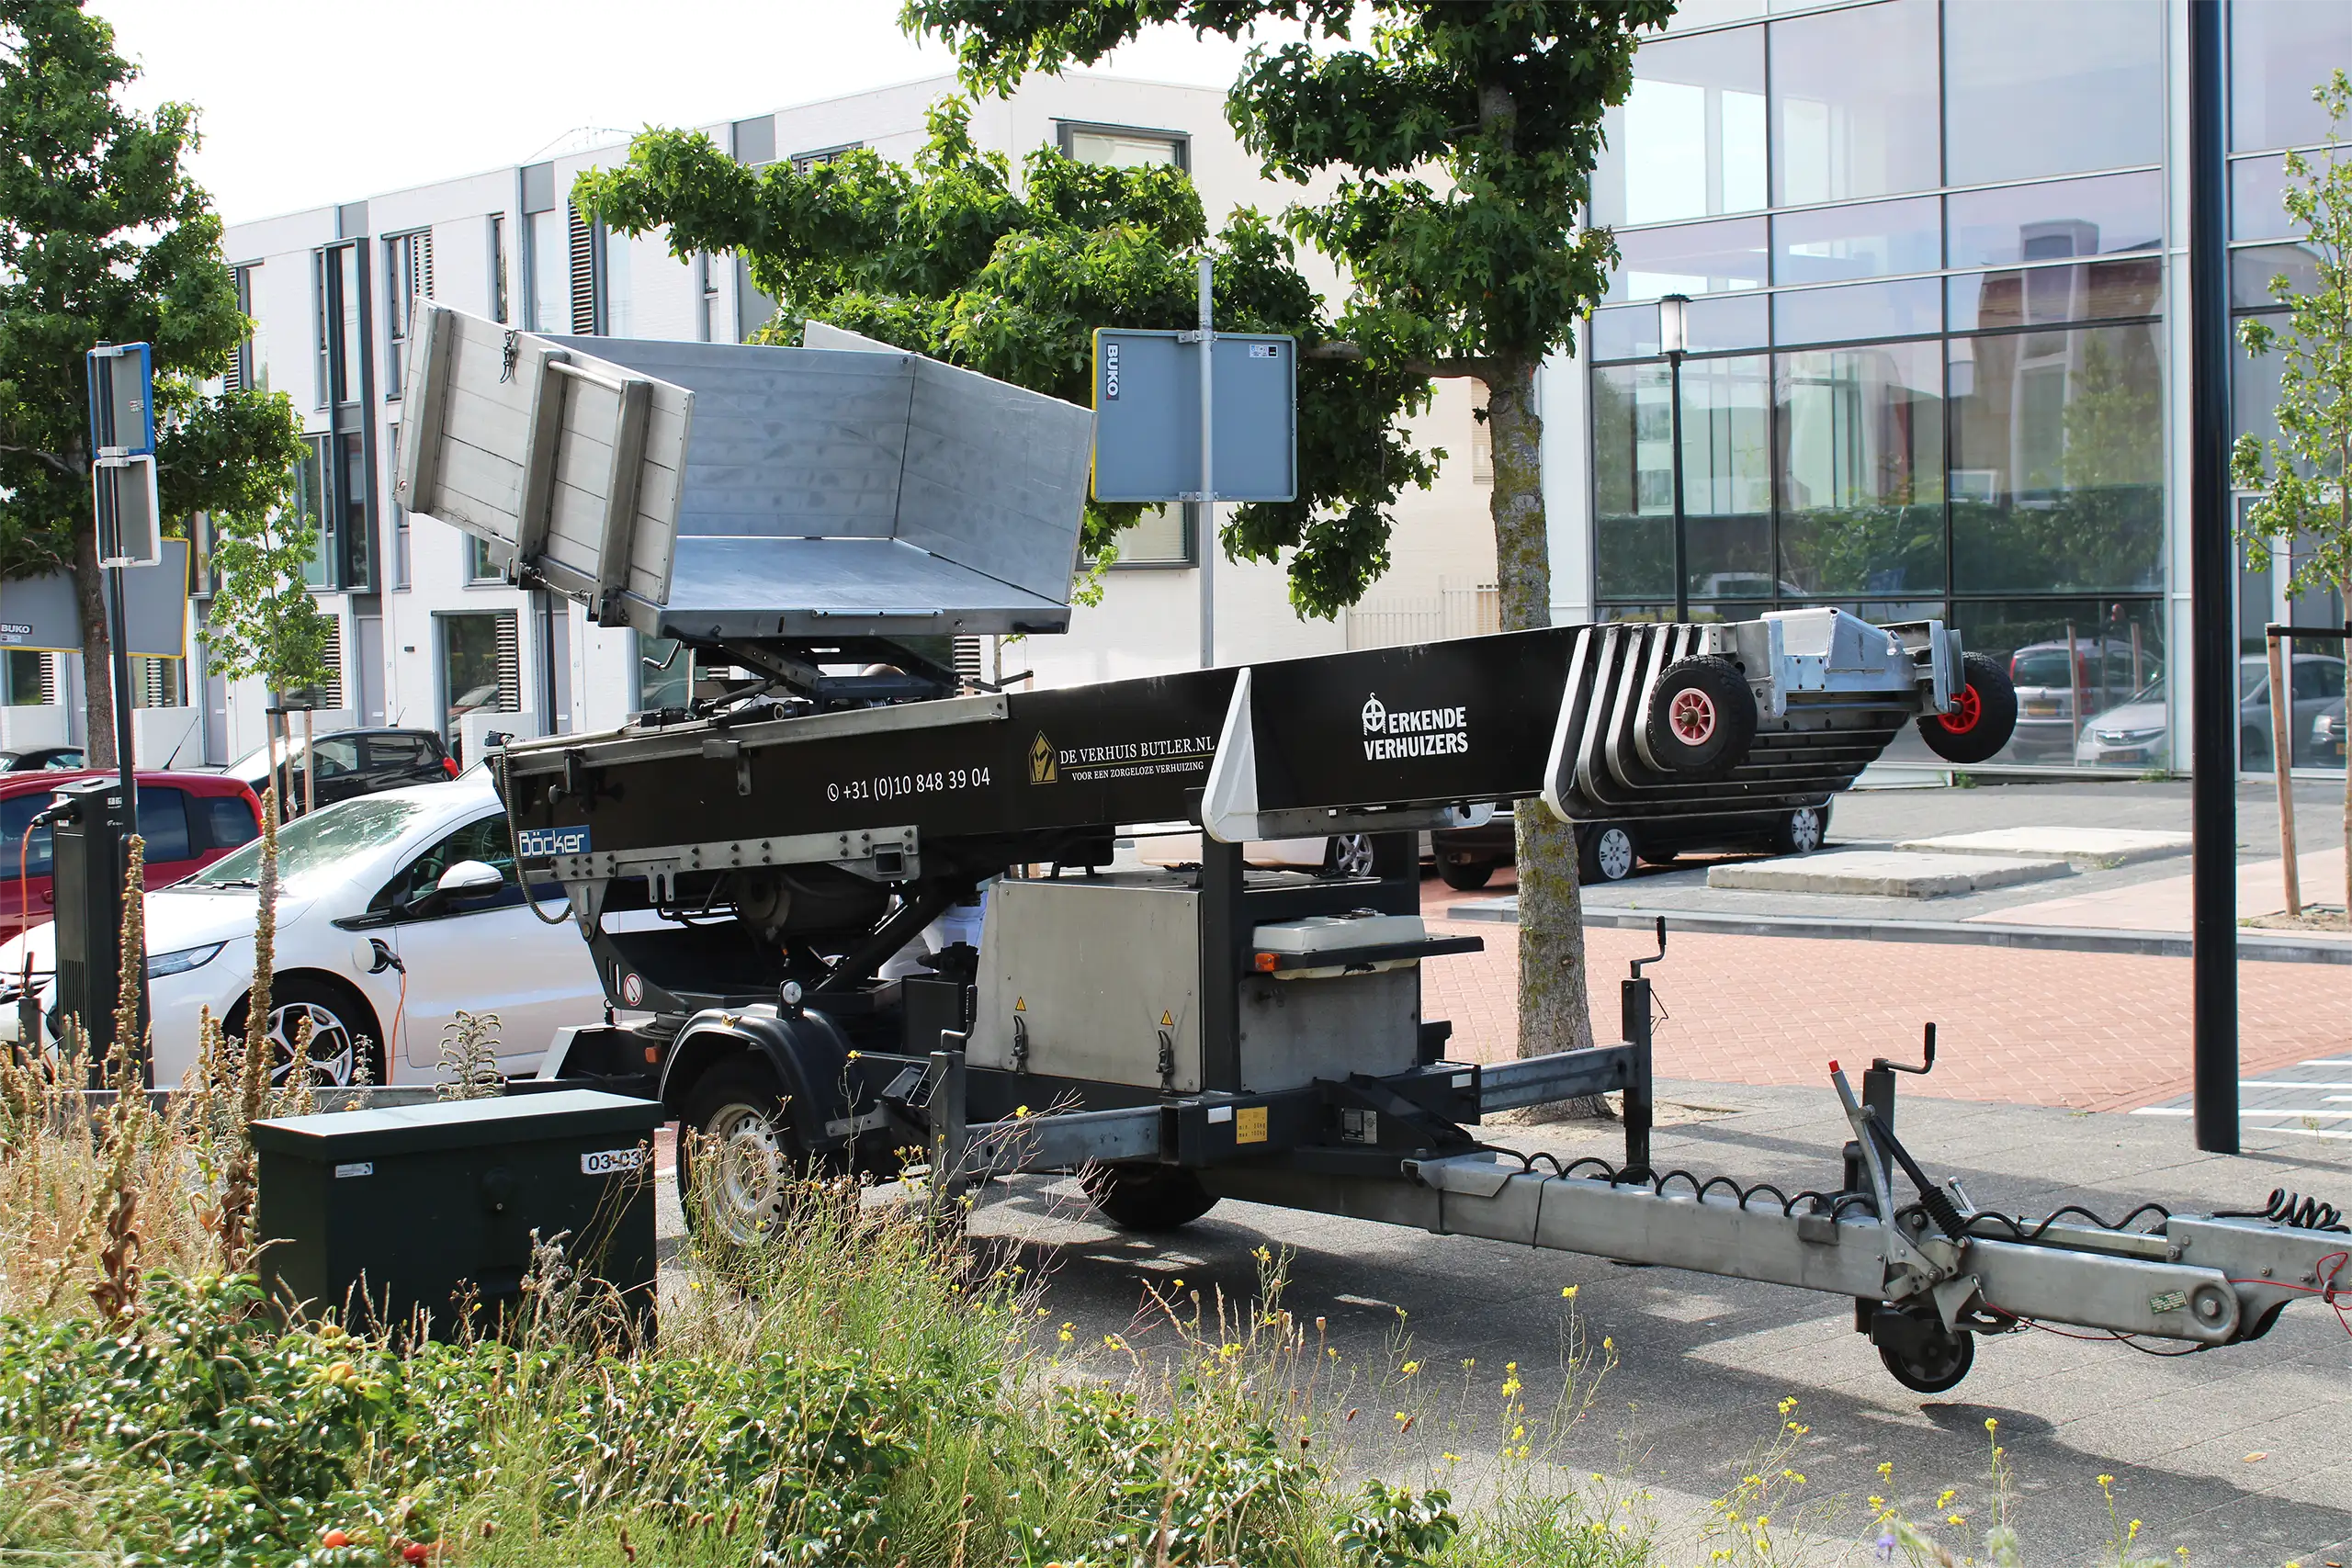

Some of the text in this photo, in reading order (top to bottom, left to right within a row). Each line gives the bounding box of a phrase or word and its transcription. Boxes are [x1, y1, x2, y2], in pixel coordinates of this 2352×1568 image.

[1107, 344, 1119, 396] BUKO
[1, 624, 30, 634] BUKO
[1388, 706, 1467, 734] ERKENDE
[1059, 736, 1216, 764] DE VERHUIS BUTLER.NL
[1363, 731, 1468, 761] VERHUIZERS
[842, 767, 990, 801] +31 (0)10 848 39 04
[1071, 761, 1204, 781] VOOR EEN ZORGELOZE VERHUIZING
[518, 829, 585, 857] Böcker
